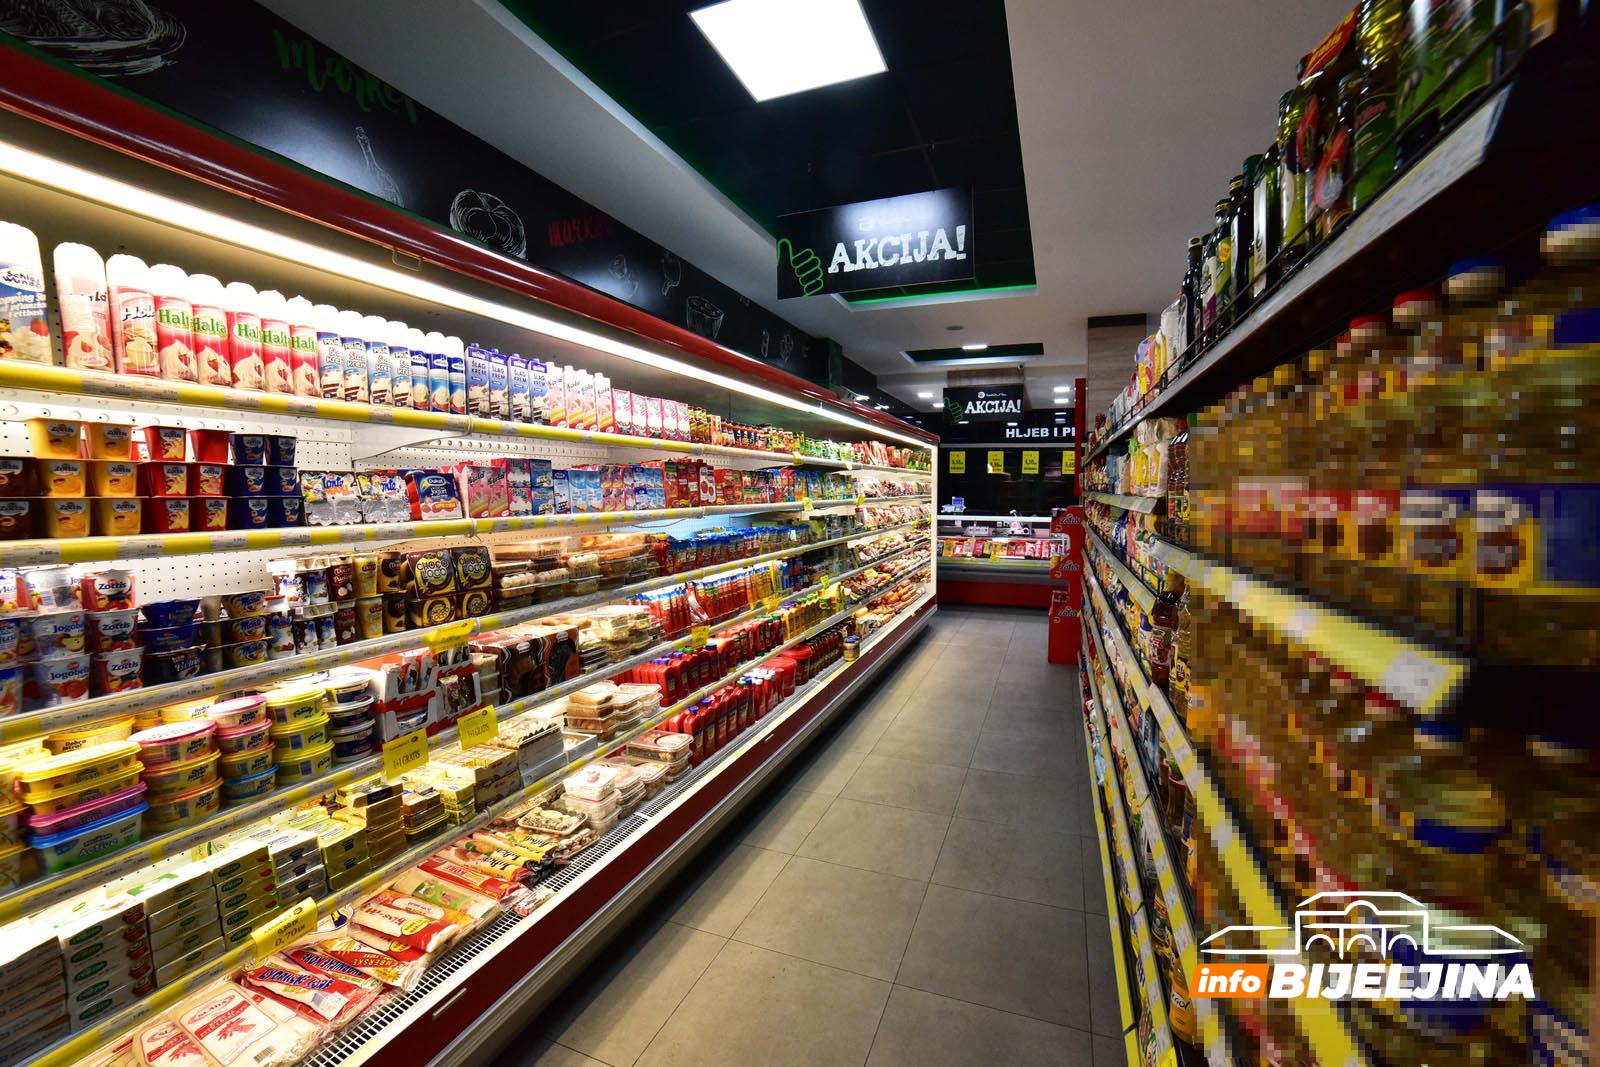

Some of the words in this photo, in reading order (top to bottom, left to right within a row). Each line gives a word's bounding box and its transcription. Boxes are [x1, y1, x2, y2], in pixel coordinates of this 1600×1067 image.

[828, 224, 966, 274] AKCIJA!
[964, 399, 1021, 414] AKCIJA!
[1005, 428, 1049, 438] HLJEB
[417, 559, 448, 572] CHOCO
[458, 555, 487, 566] CHOCO
[423, 567, 447, 579] LOCO
[464, 563, 486, 573] LOCO
[98, 580, 127, 591] Zottis
[102, 621, 130, 632] Zottis
[111, 661, 139, 672] Zottis
[402, 751, 420, 764] GRATIS
